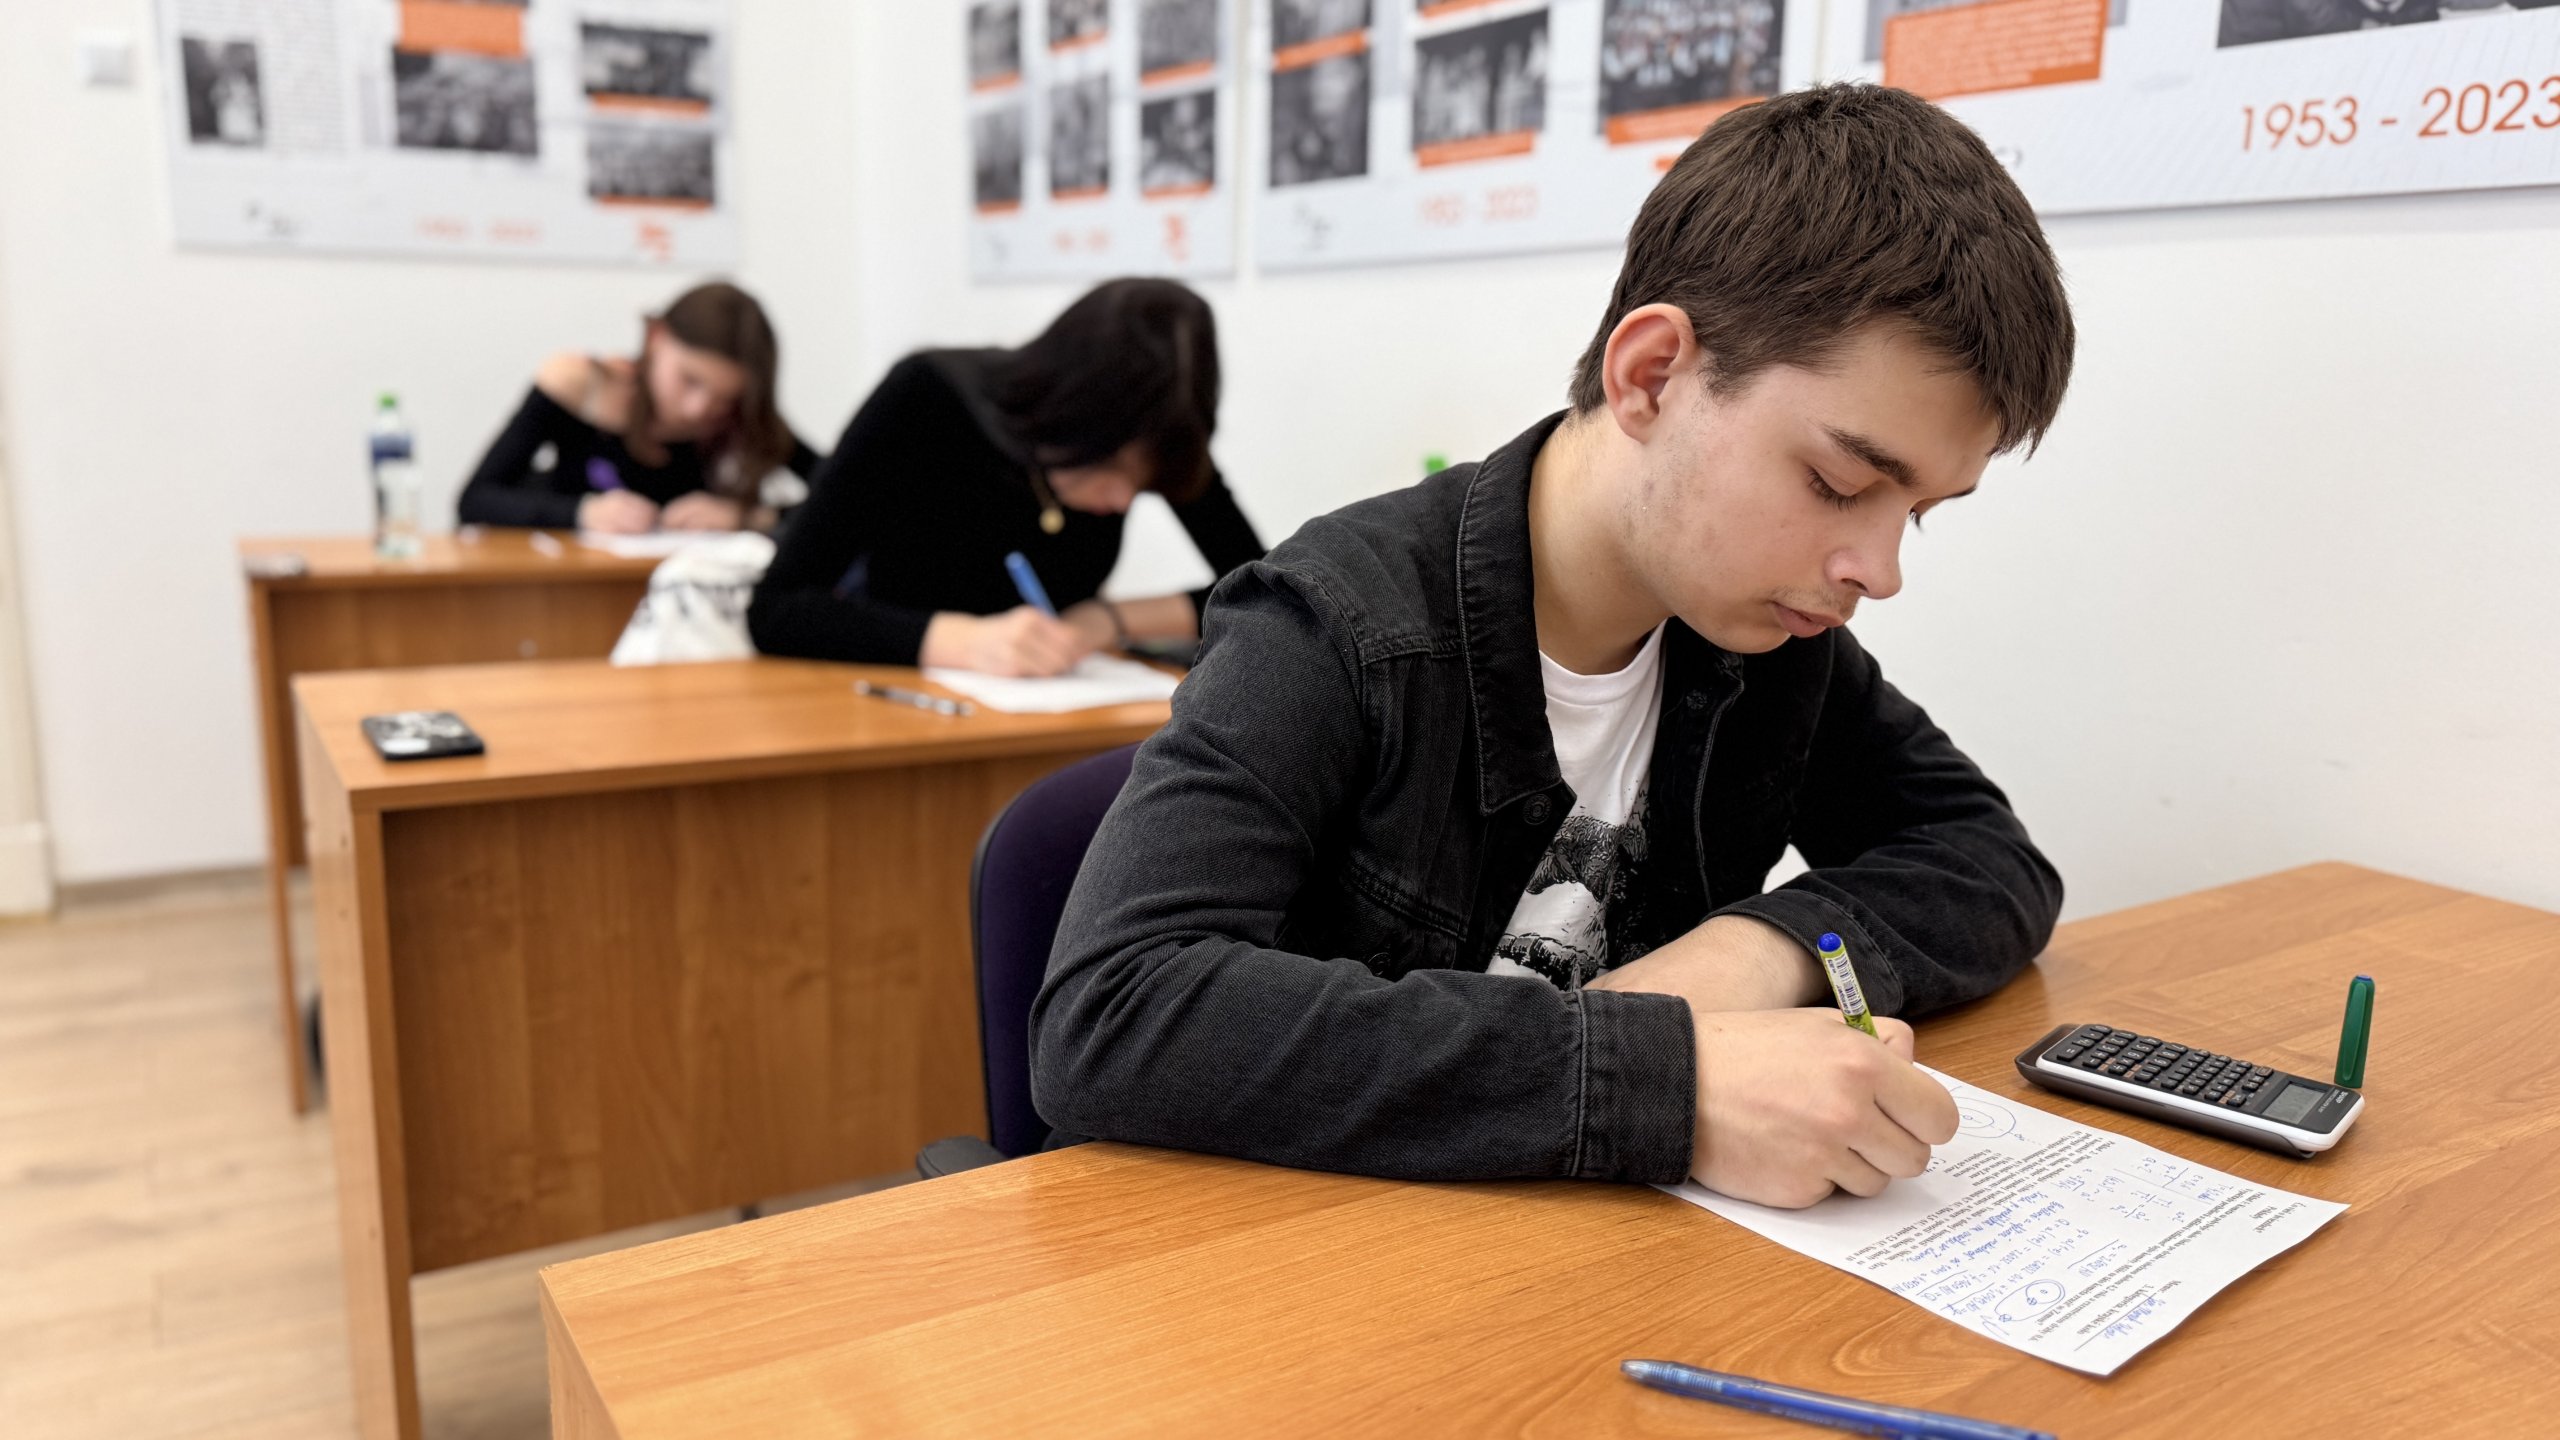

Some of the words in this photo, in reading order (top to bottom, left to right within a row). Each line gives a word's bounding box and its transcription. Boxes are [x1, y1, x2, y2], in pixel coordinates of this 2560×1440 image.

[2242, 96, 2358, 151] 1953
[2379, 117, 2398, 126] -
[2416, 74, 2560, 138] 2023
